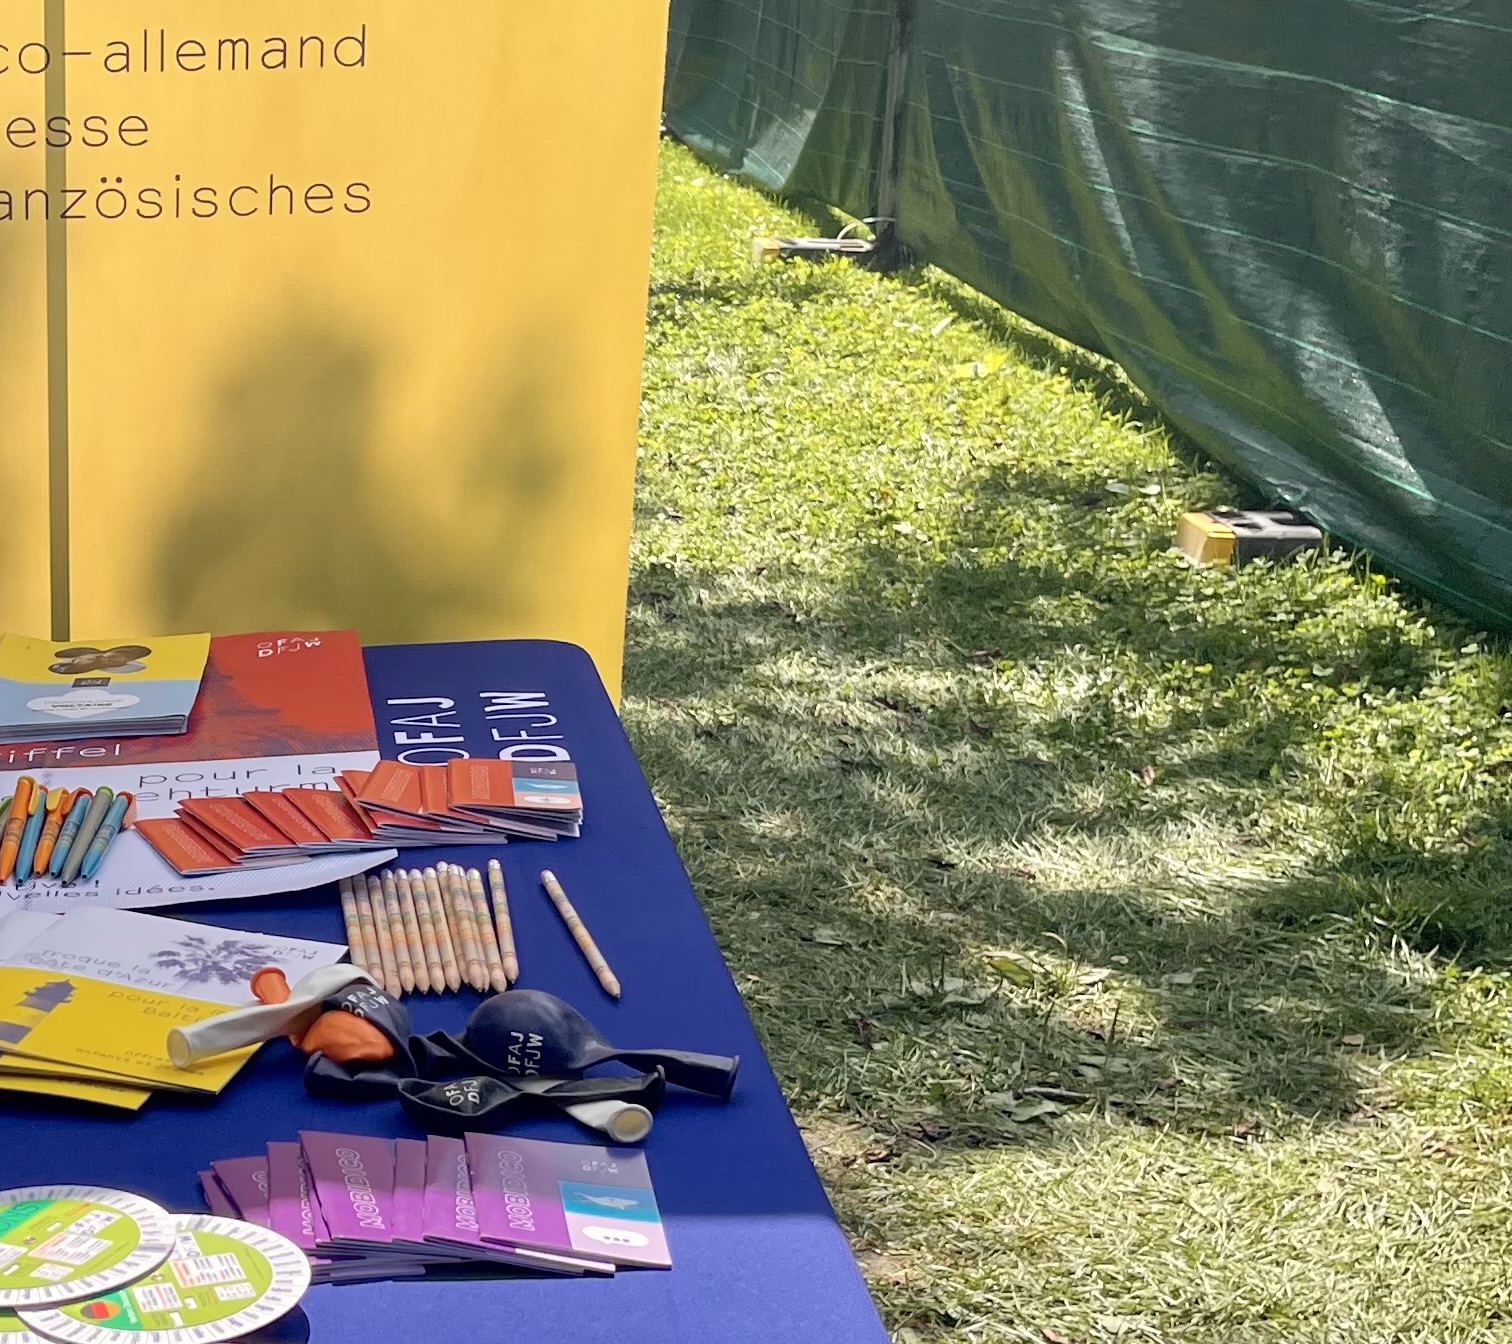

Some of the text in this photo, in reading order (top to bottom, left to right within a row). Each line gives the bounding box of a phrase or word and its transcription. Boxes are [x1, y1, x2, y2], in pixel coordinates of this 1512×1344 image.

[387, 697, 470, 766] OFAJ
[479, 691, 571, 761] DFJW
[140, 768, 267, 788] pour
[297, 764, 336, 776] la
[39, 949, 151, 976] Troque la
[107, 989, 170, 1008] pour
[180, 1000, 200, 1013] la
[141, 1006, 203, 1023] Balti
[461, 1079, 480, 1105] DFJ
[336, 1147, 386, 1230] MOBIDICO
[498, 1150, 536, 1232] MOBIDICO
